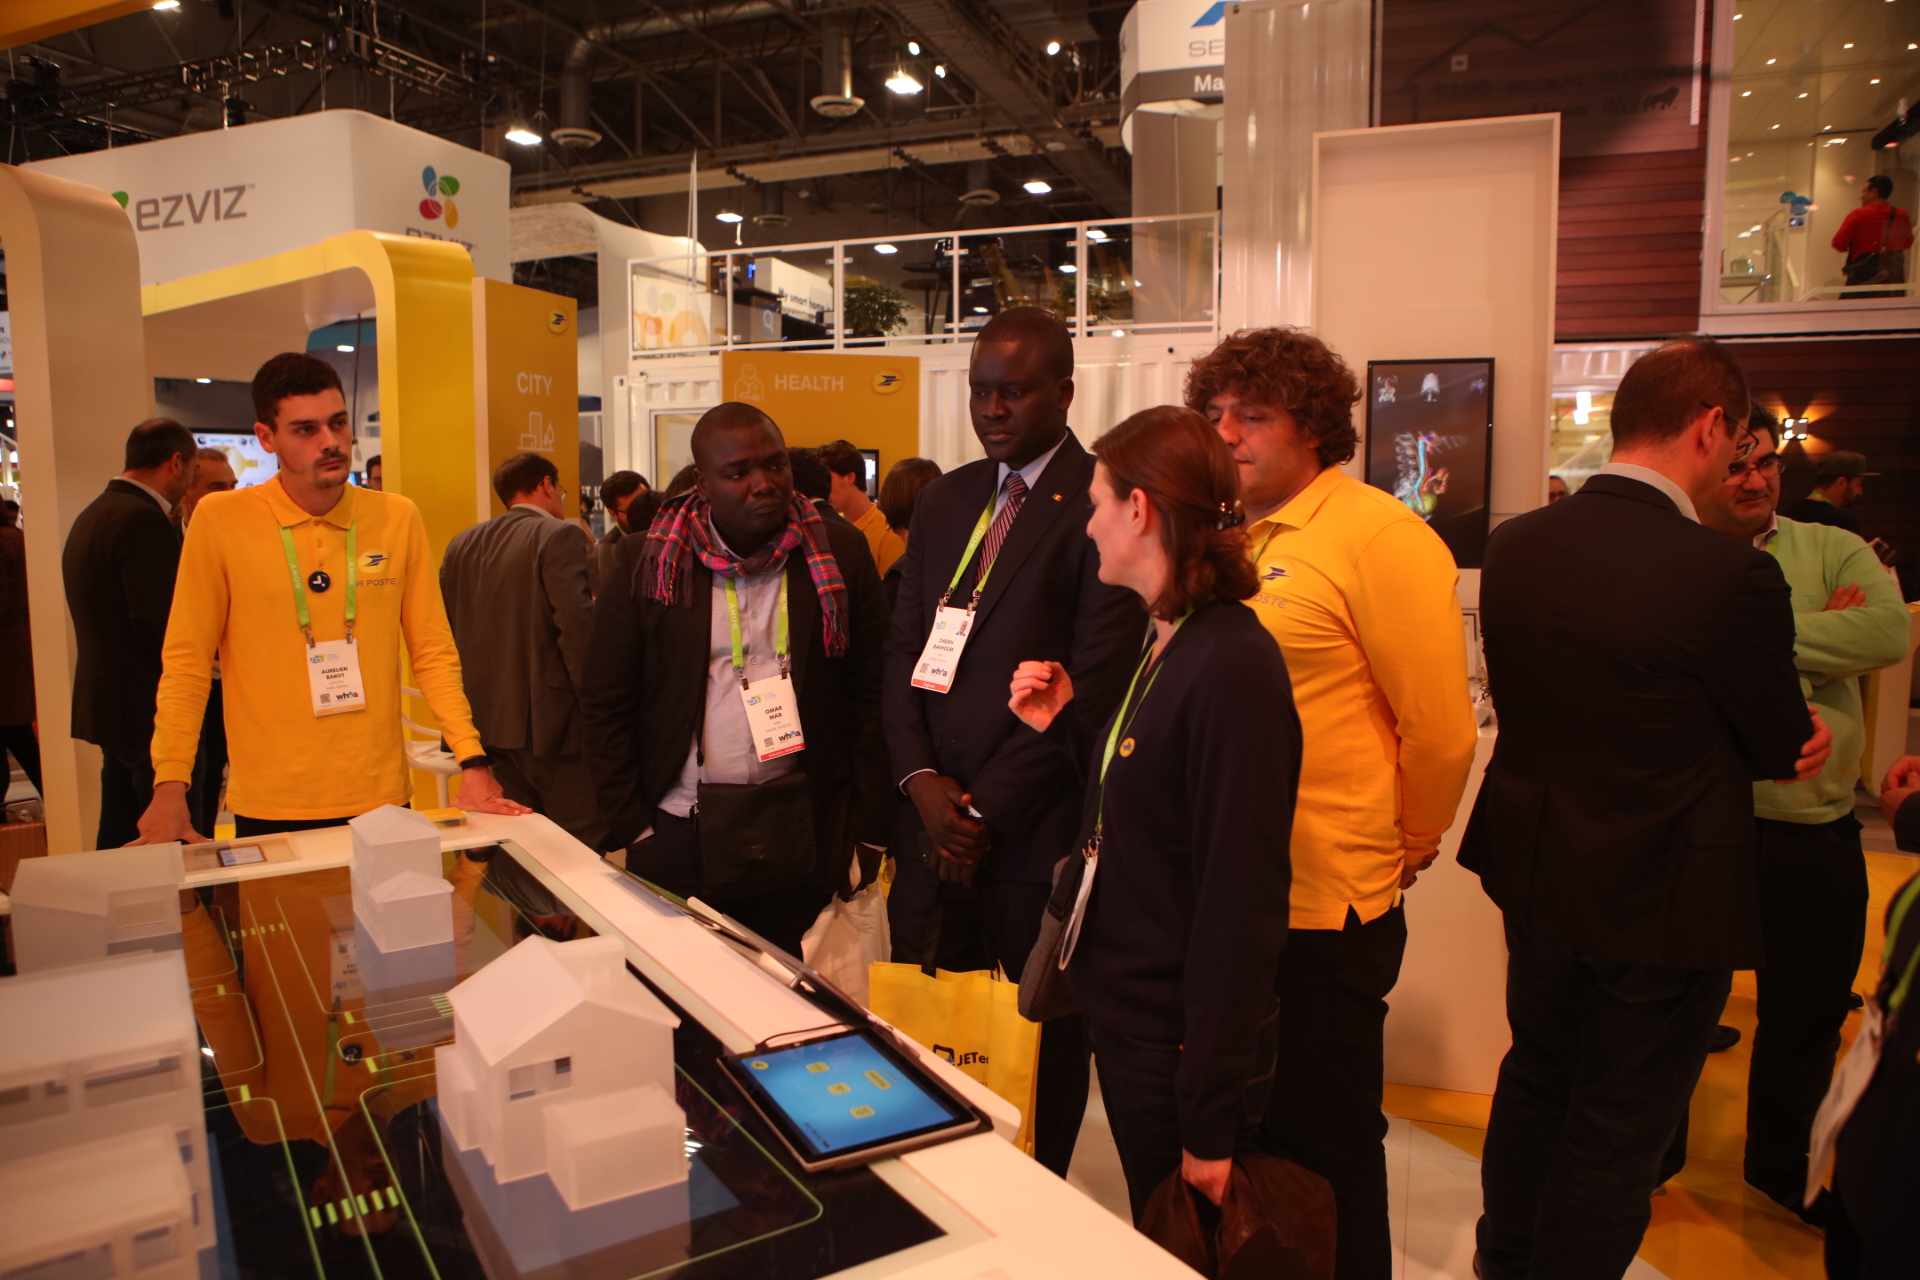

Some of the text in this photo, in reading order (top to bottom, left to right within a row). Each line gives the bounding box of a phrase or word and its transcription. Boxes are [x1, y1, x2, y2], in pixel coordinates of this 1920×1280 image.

[516, 371, 553, 396] CITY
[774, 374, 845, 391] HEALTH
[968, 523, 985, 549] SONY
[291, 564, 302, 589] SONY
[366, 577, 396, 588] POSTE
[781, 587, 789, 612] SONY
[1253, 594, 1288, 610] OSTE
[729, 603, 738, 629] SONY
[321, 666, 349, 674] AURELIEN
[764, 705, 783, 715] OMAR
[769, 712, 783, 721] MAR
